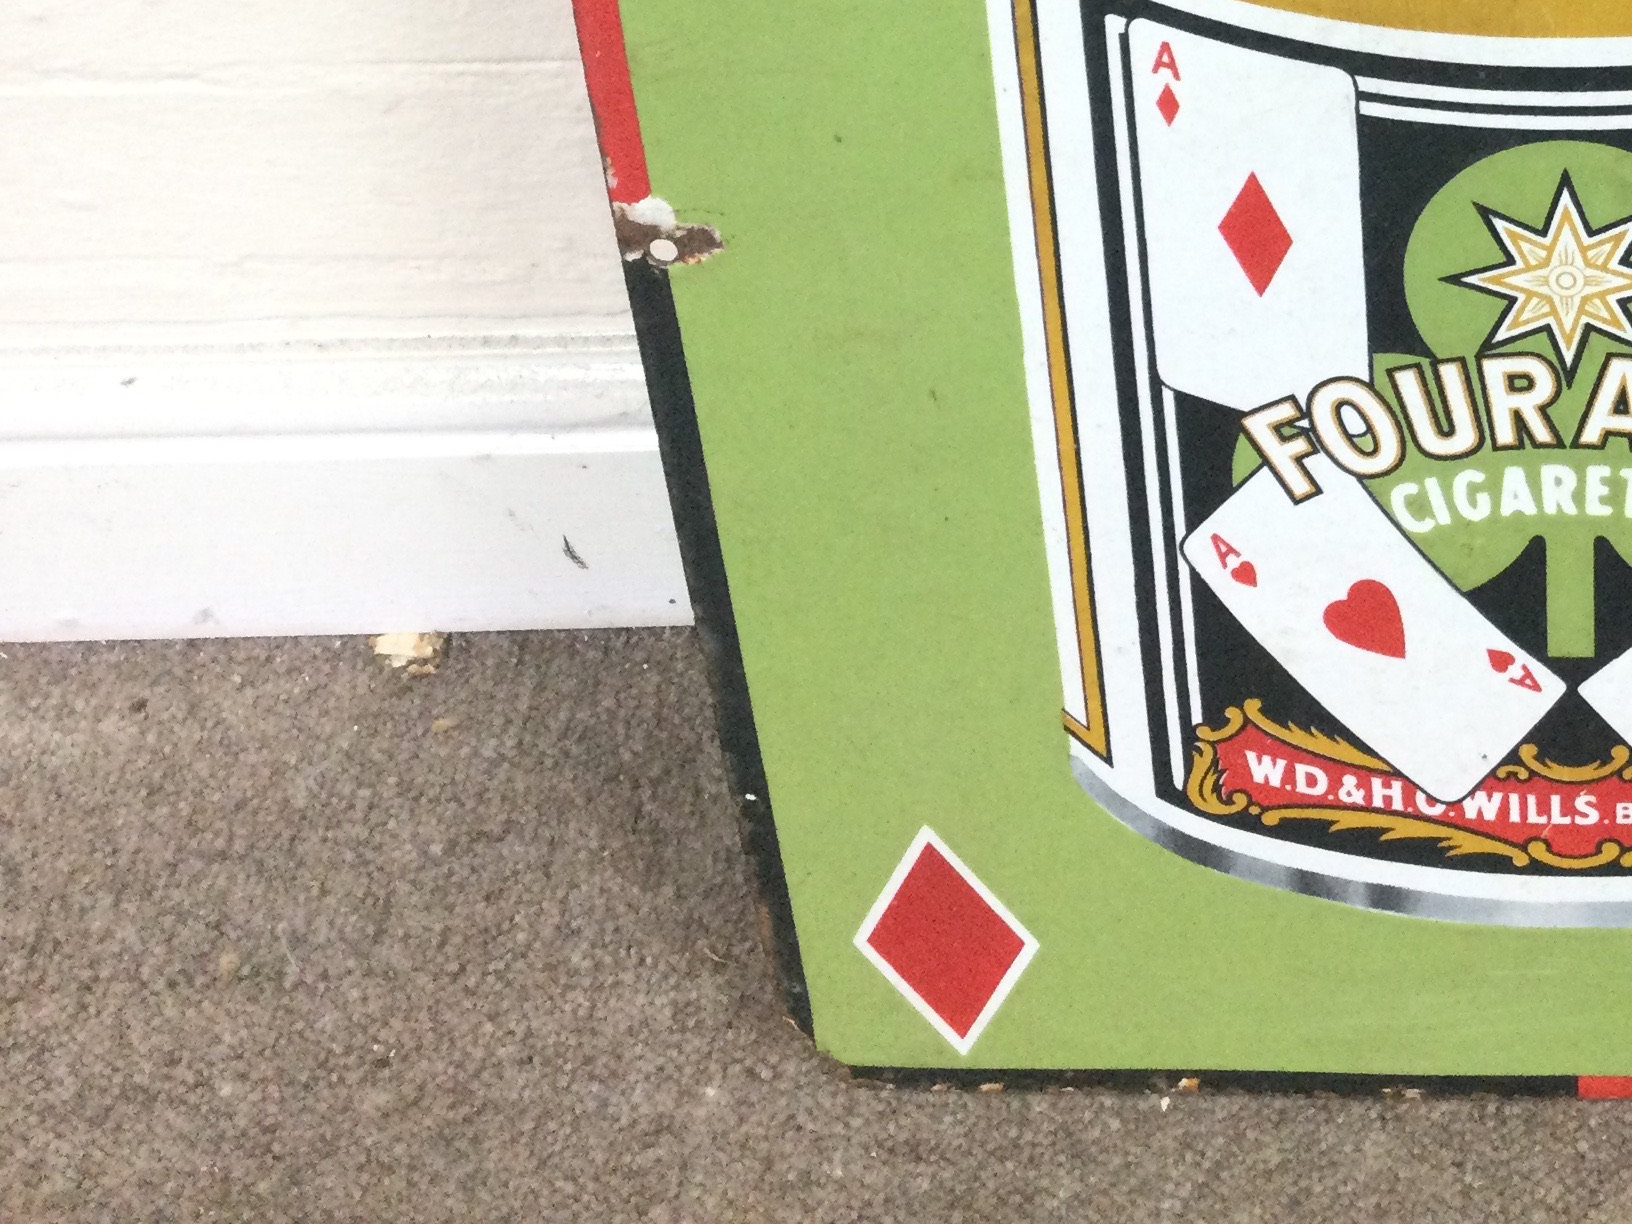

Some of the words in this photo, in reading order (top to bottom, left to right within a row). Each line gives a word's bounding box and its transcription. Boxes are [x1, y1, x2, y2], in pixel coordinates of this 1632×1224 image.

[1151, 41, 1181, 82] A
[1240, 354, 1565, 505] FOUR
[1210, 533, 1241, 570] A
[1508, 663, 1543, 693] A
